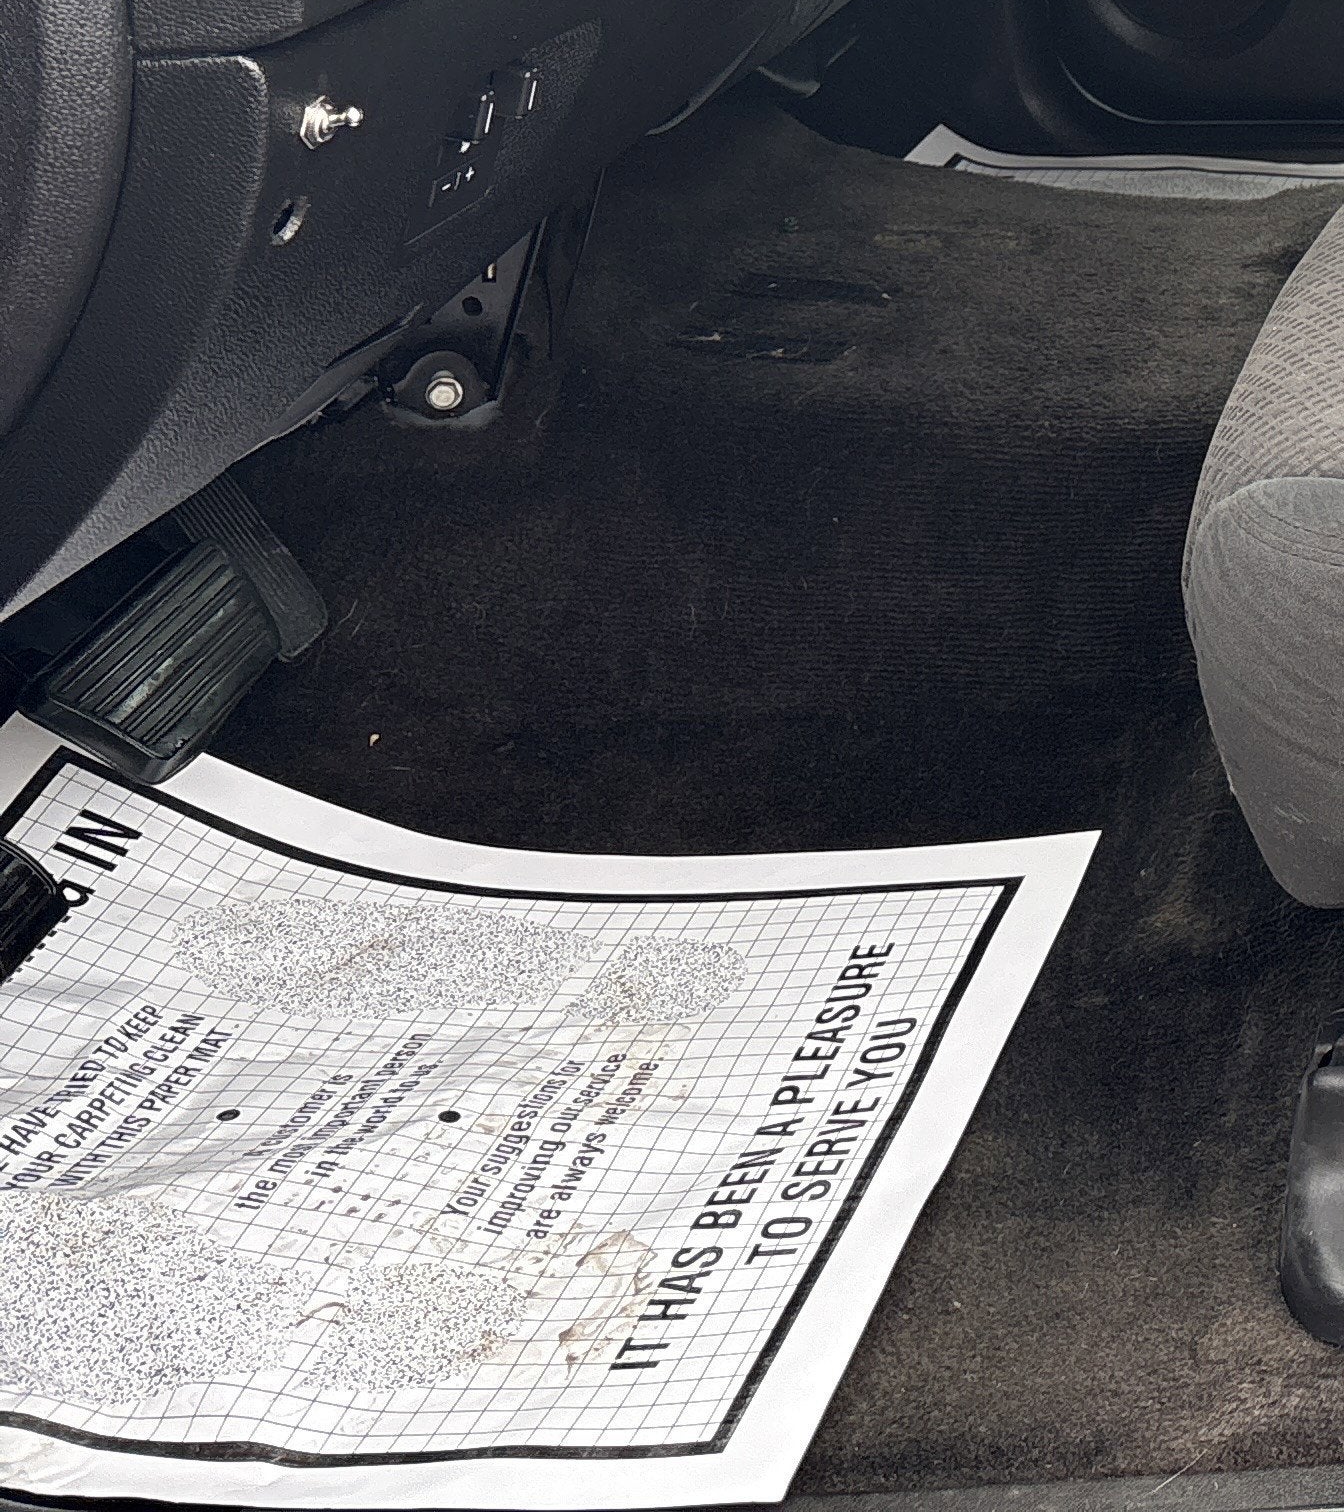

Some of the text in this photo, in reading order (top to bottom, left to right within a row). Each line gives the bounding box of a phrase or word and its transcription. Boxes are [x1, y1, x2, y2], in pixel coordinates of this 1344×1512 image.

[52, 809, 143, 873] IN
[0, 1004, 163, 1155] HAVE TRIED TO KEEP
[0, 1013, 205, 1190] YOUR CARPETING CLEAN
[50, 1151, 112, 1187] WITH
[97, 1115, 151, 1149] THIS
[138, 1064, 203, 1111] PAPER
[234, 1033, 432, 1210] the most important person
[261, 1088, 337, 1147] customer
[322, 1073, 353, 1085] is
[304, 1159, 340, 1178] in
[323, 1137, 364, 1155] the
[354, 1095, 405, 1134] world
[389, 1080, 420, 1094] to
[440, 1059, 586, 1216] Your suggestions for
[477, 1053, 627, 1235] improving our service
[608, 940, 895, 1371] IT HAS BEEN A PLEASURE
[745, 1016, 917, 1266] TO SERVE YOU
[525, 1209, 562, 1239] are
[550, 1132, 607, 1201] always
